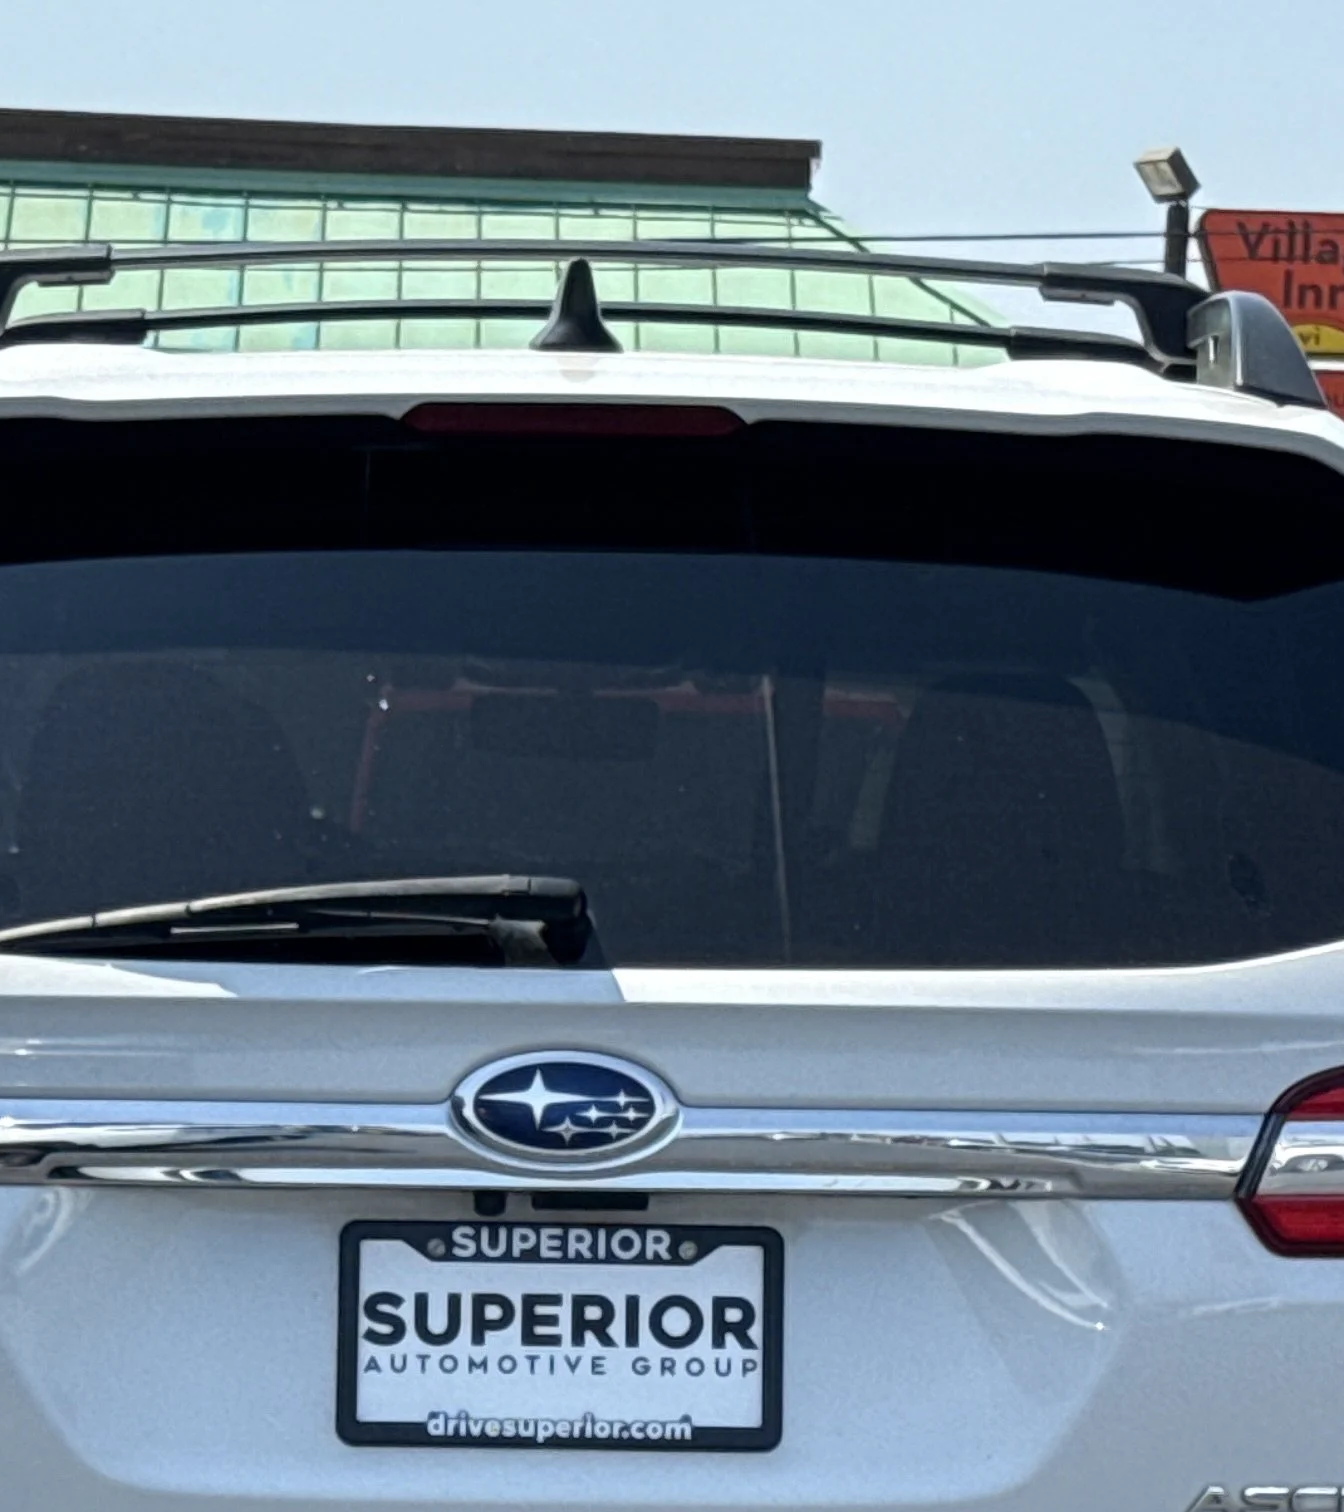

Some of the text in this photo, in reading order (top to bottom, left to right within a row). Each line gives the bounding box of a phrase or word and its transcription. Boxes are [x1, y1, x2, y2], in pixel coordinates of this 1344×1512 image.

[451, 1225, 673, 1261] SUPERIOR
[361, 1291, 759, 1351] SUPERIOR
[363, 1354, 759, 1378] AUTOMOTIVE GROUP
[426, 1411, 694, 1443] drivesuperior.com
